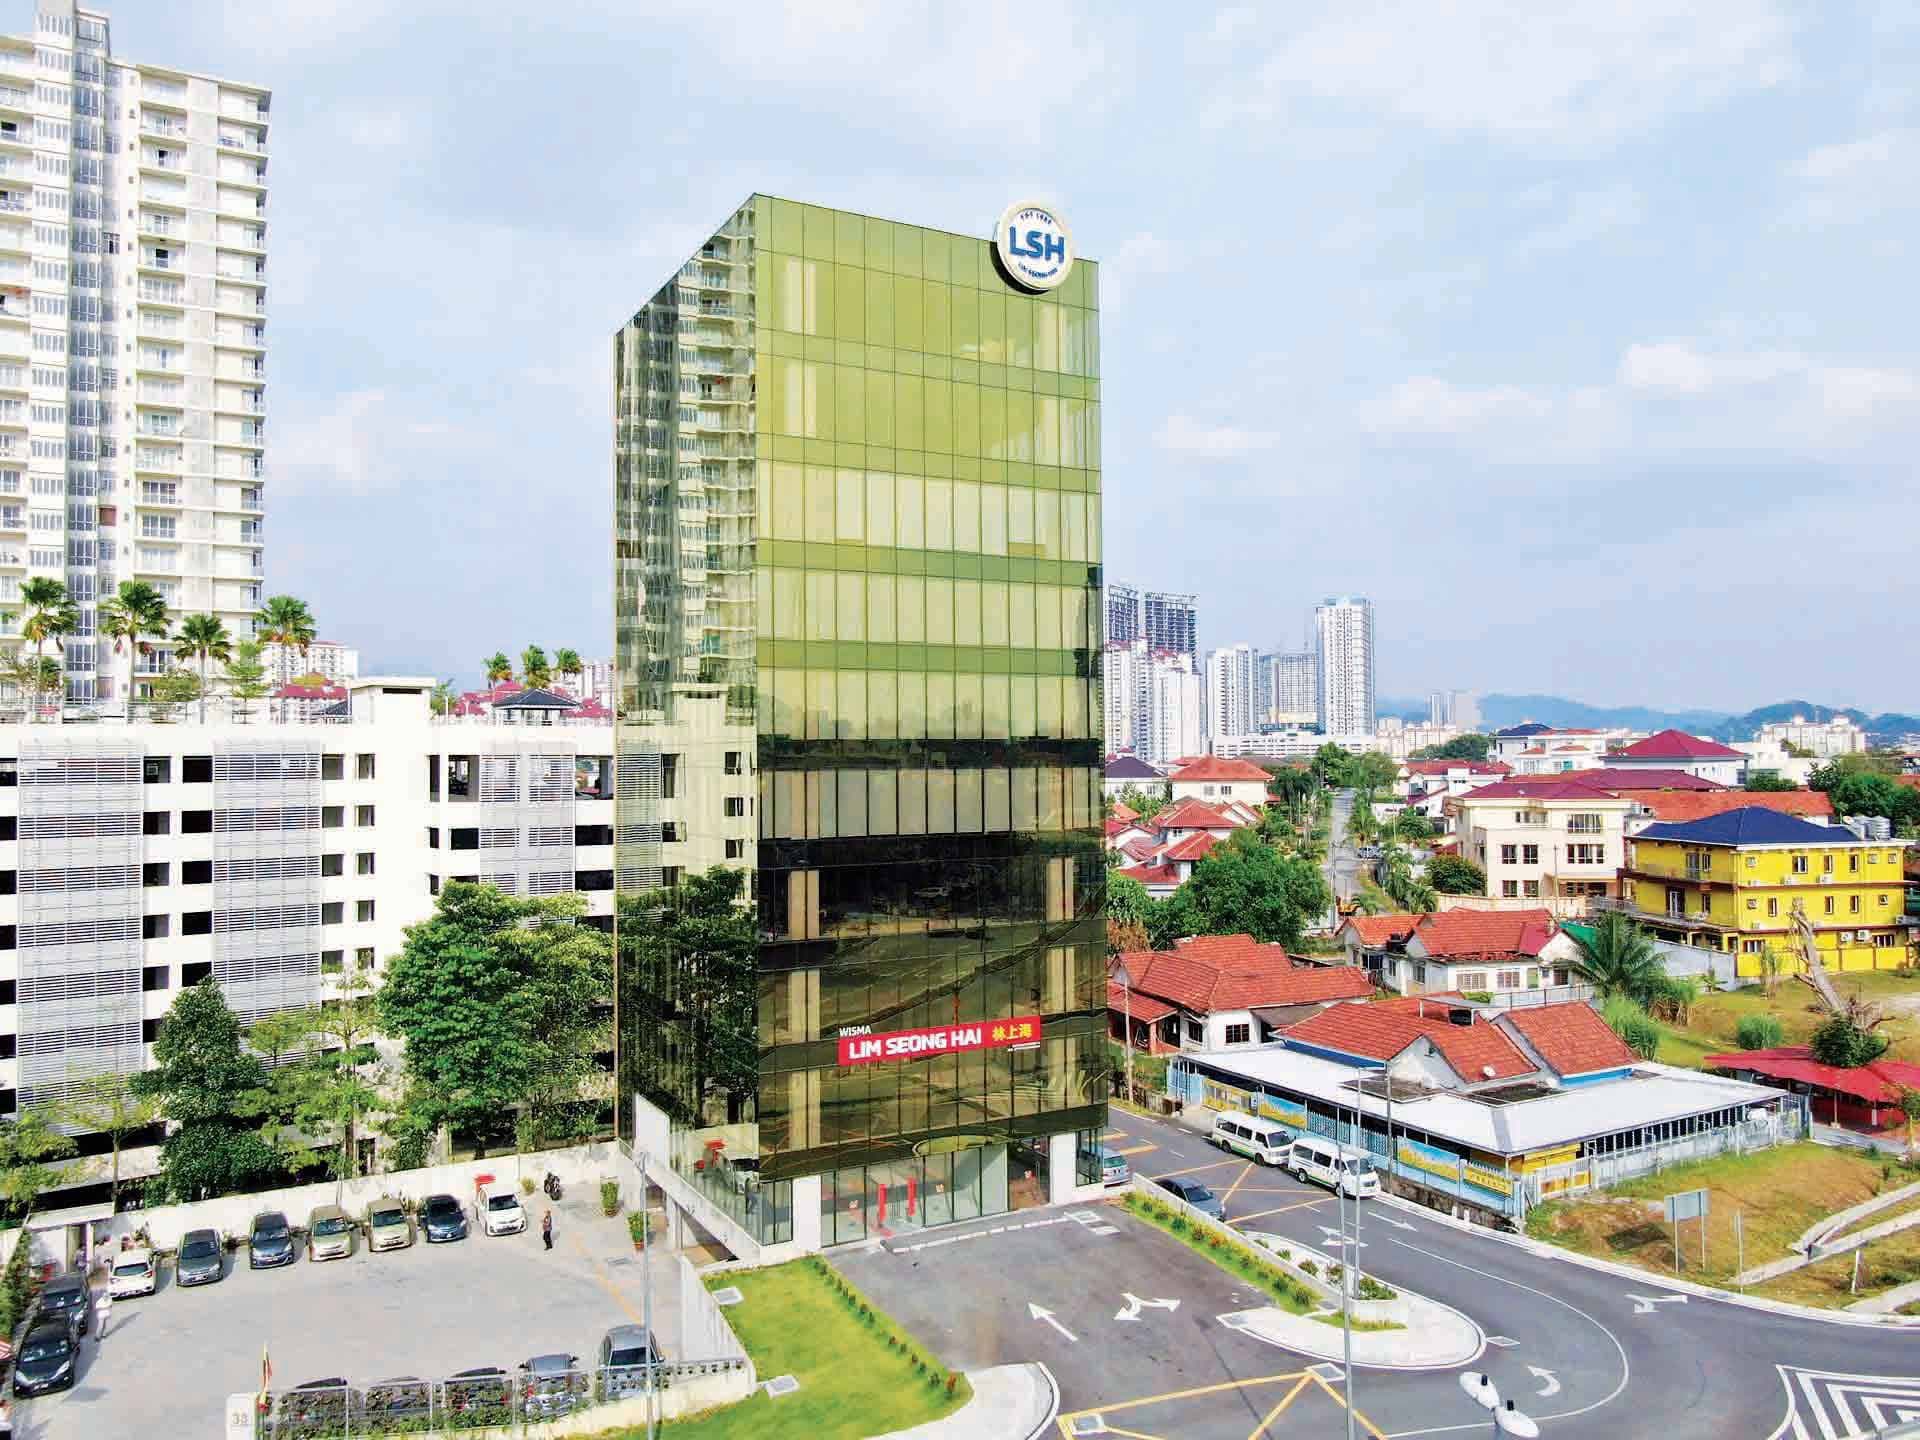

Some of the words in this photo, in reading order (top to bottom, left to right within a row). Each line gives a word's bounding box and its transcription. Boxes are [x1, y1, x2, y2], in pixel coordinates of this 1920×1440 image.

[1009, 226, 1065, 264] LSH
[839, 1025, 872, 1037] WISMA
[848, 1039, 881, 1059] LIM
[885, 1032, 946, 1056] SEONG
[951, 1028, 982, 1047] HAI
